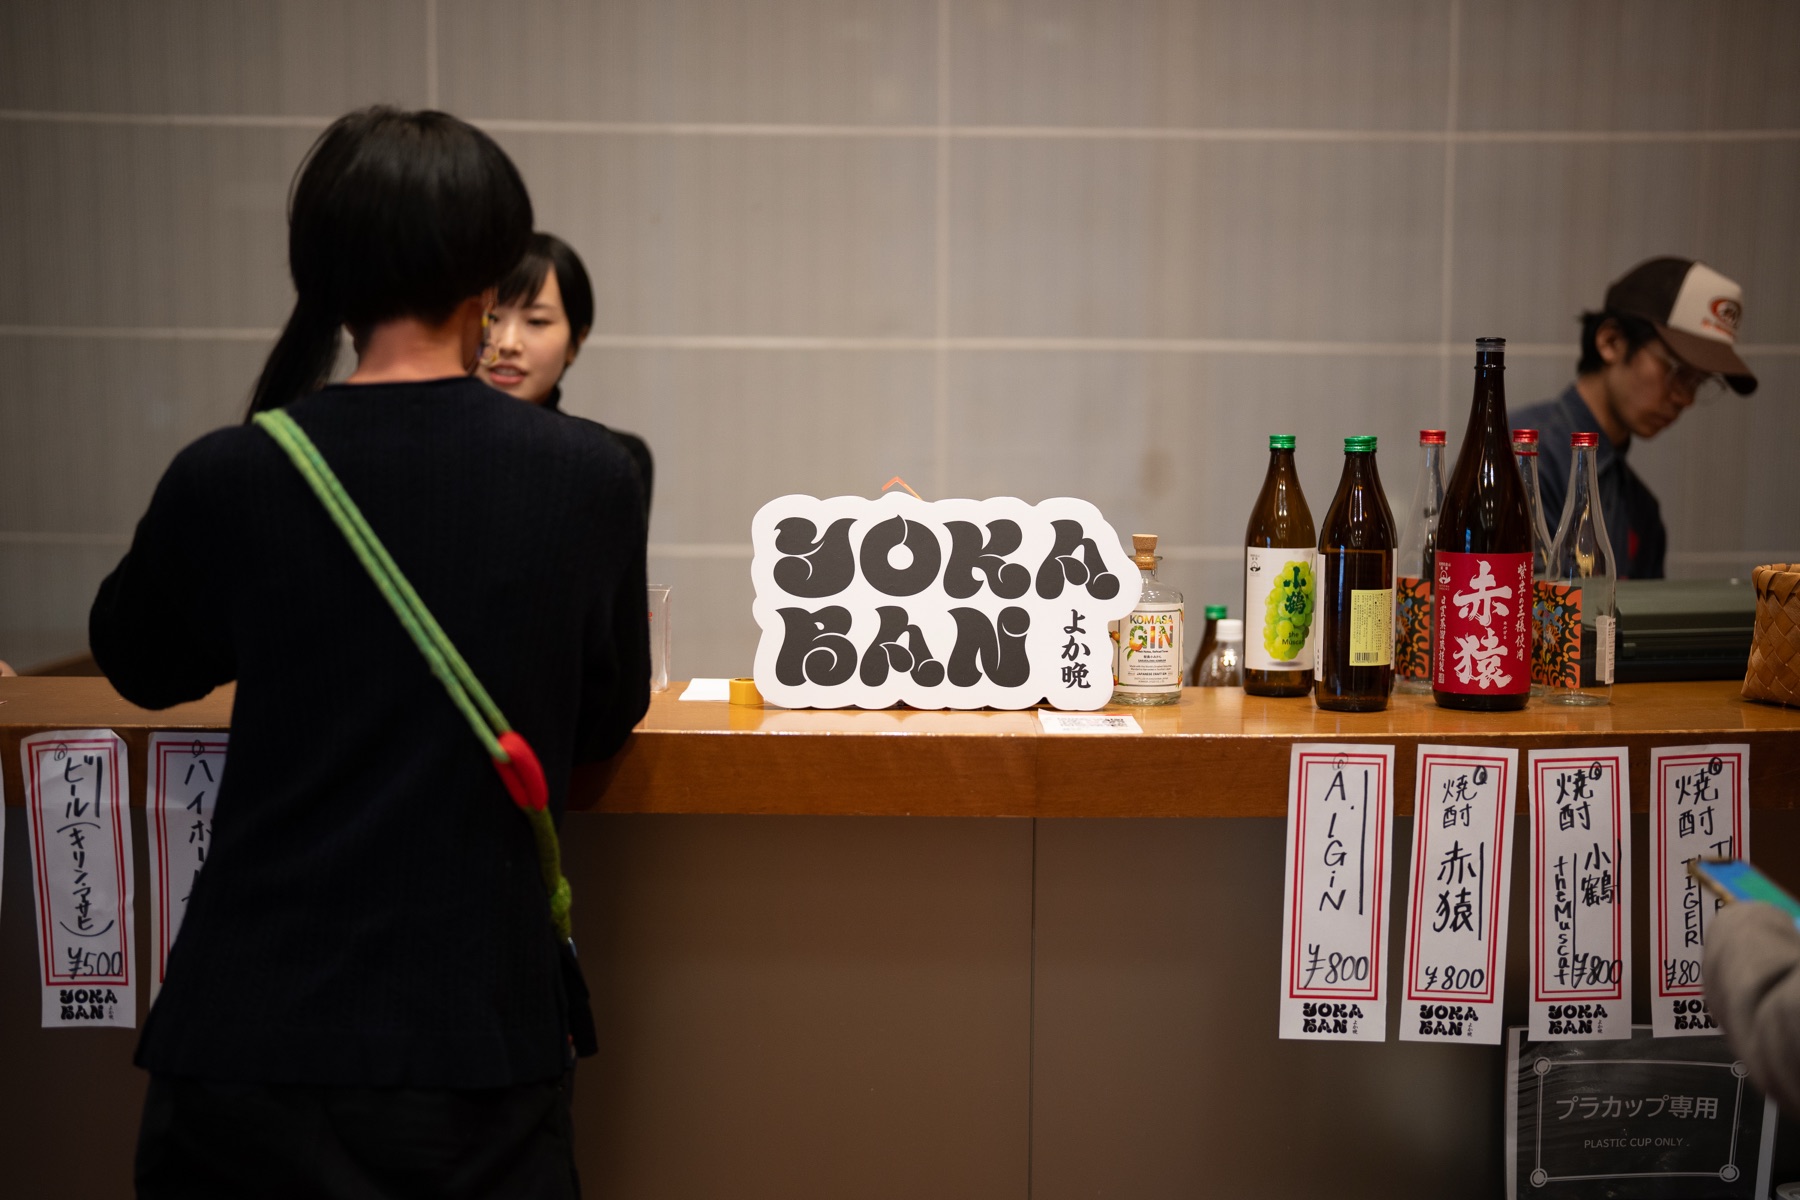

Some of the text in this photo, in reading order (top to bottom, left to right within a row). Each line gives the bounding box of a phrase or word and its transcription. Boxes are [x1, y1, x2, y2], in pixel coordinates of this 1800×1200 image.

[773, 515, 1120, 600] YOKA
[1283, 566, 1307, 615] 小鶴
[1129, 614, 1174, 625] KOMASA
[1453, 560, 1513, 690] 赤猿
[775, 605, 1030, 688] BAN
[1060, 609, 1091, 689] よか晩
[1129, 625, 1174, 651] GIN
[1556, 769, 1594, 831] 焼酎
[1675, 769, 1719, 838] 焼酎
[1432, 774, 1477, 932] 焼酎 赤猿
[1581, 843, 1613, 907] 小鶴
[67, 947, 122, 979] ¥500
[1304, 943, 1369, 988] ¥800
[1664, 959, 1701, 991] ¥80
[1424, 965, 1485, 990] ¥800
[59, 989, 118, 1004] YOKA
[1673, 999, 1710, 1014] YO
[60, 1004, 104, 1020] BAN
[1302, 1002, 1363, 1019] YOKA
[1419, 1004, 1479, 1021] YOKA
[1548, 1004, 1608, 1019] YOKA
[1302, 1018, 1348, 1034] BAN
[1419, 1020, 1463, 1036] BAN
[1548, 1020, 1593, 1035] BAN
[1555, 1094, 1719, 1120] プラカップ専用
[1584, 1137, 1684, 1149] PLASTIC CUP ONLY
